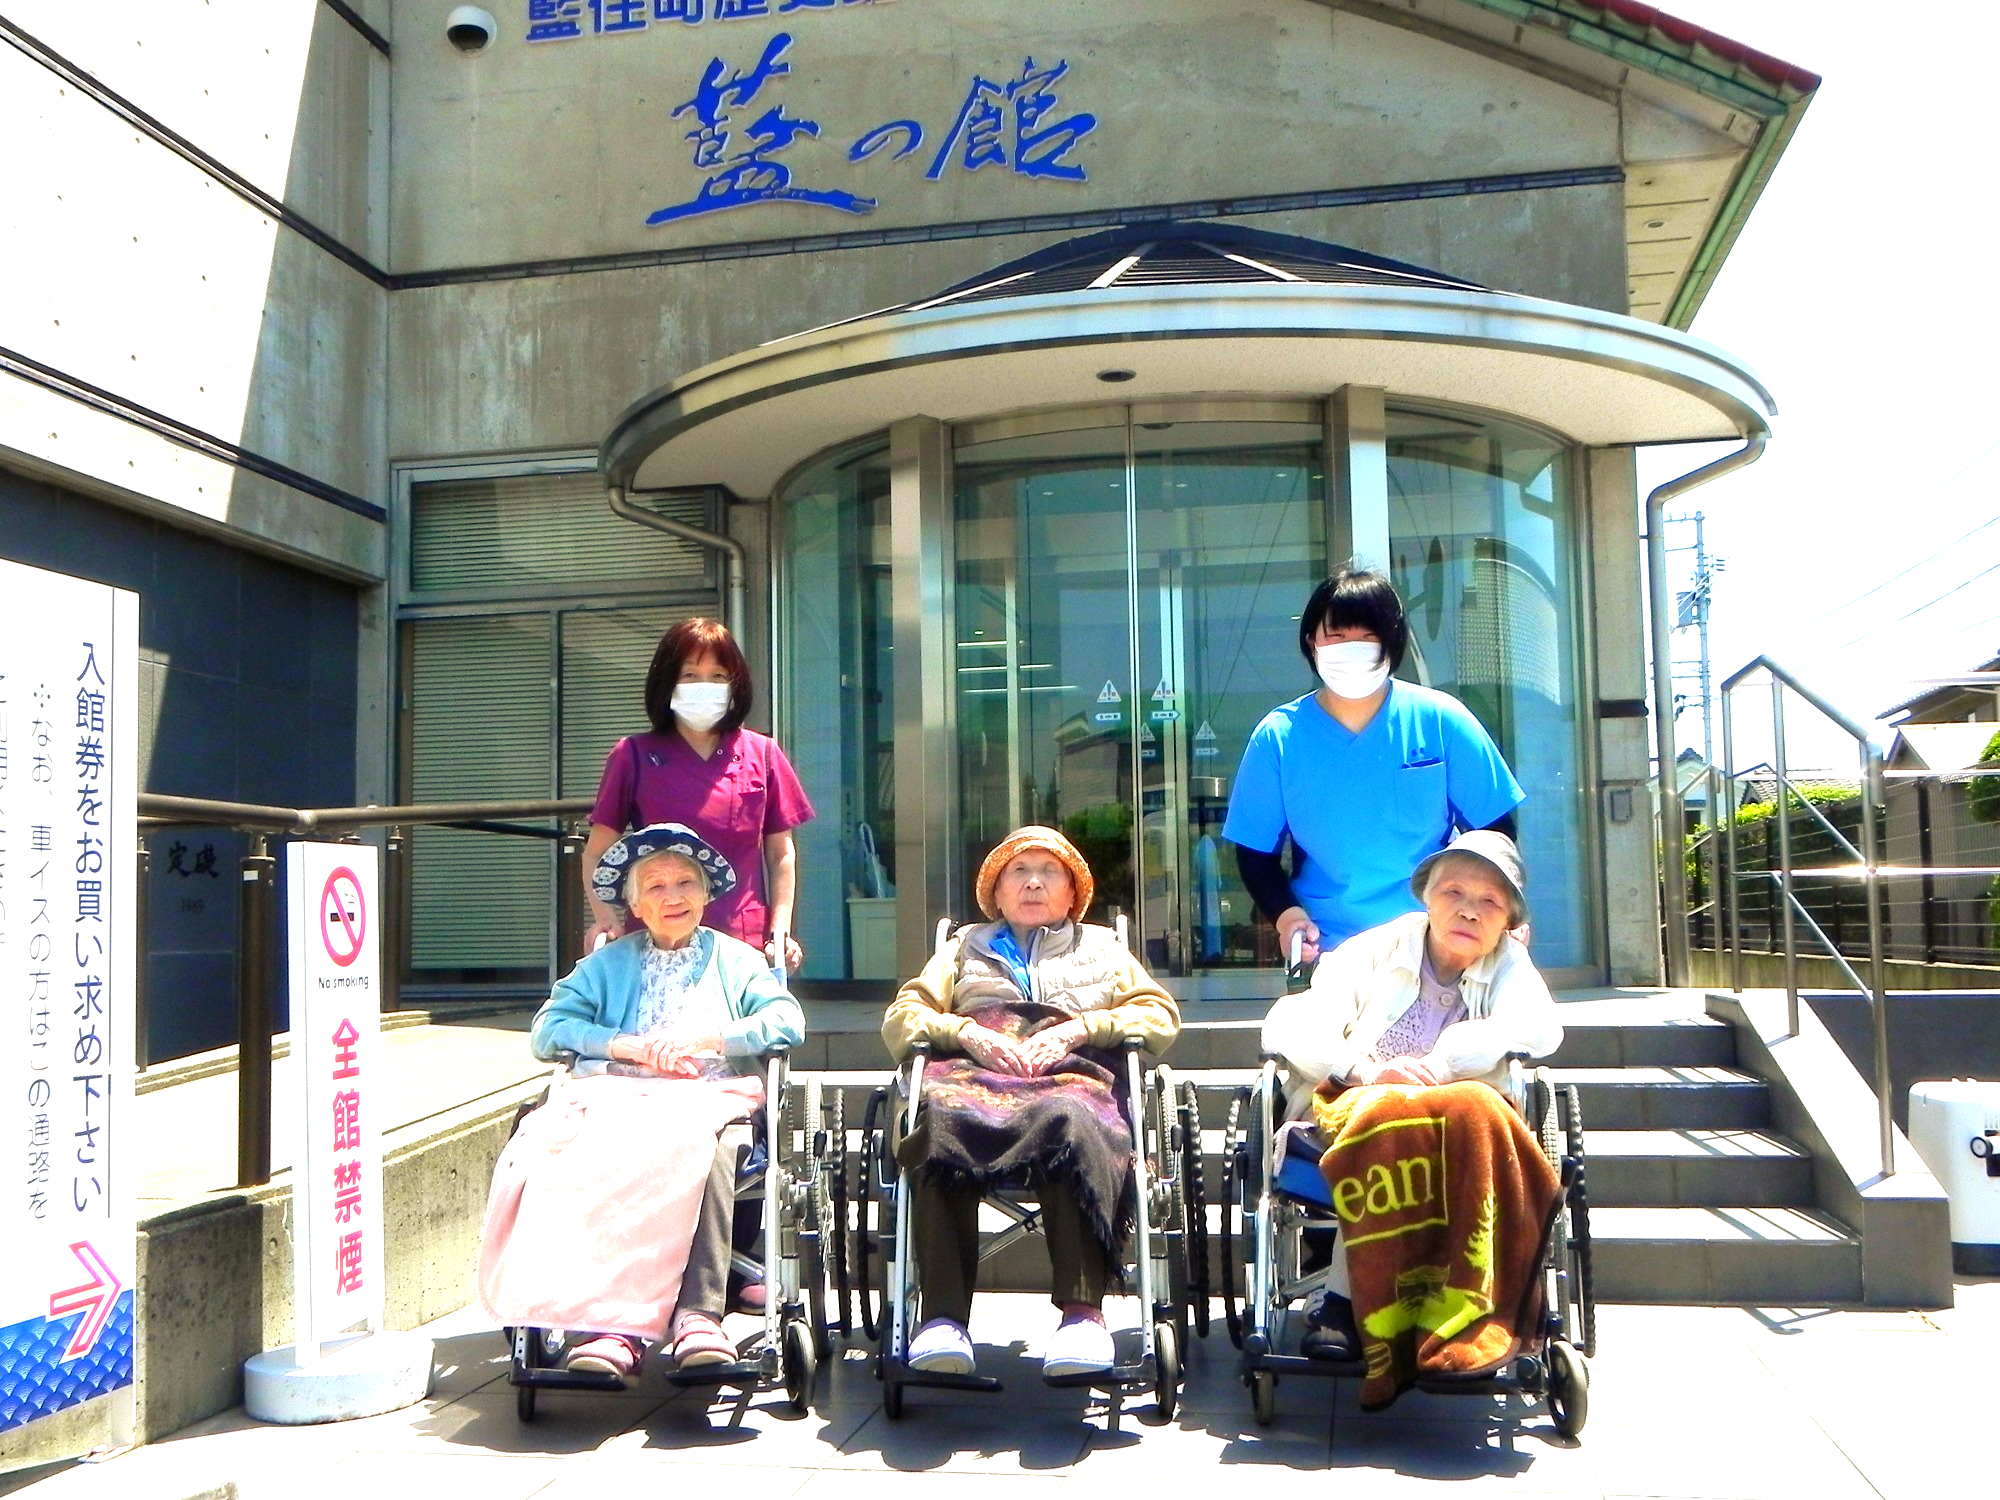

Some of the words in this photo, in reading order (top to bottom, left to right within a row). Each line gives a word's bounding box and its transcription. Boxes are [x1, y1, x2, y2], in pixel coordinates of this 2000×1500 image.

[646, 33, 1096, 226] 藍の館
[73, 642, 105, 1213] 入館券をお買い求め下さい
[319, 976, 331, 989] No
[333, 975, 369, 990] smoking
[332, 1018, 363, 1297] 全館禁煙
